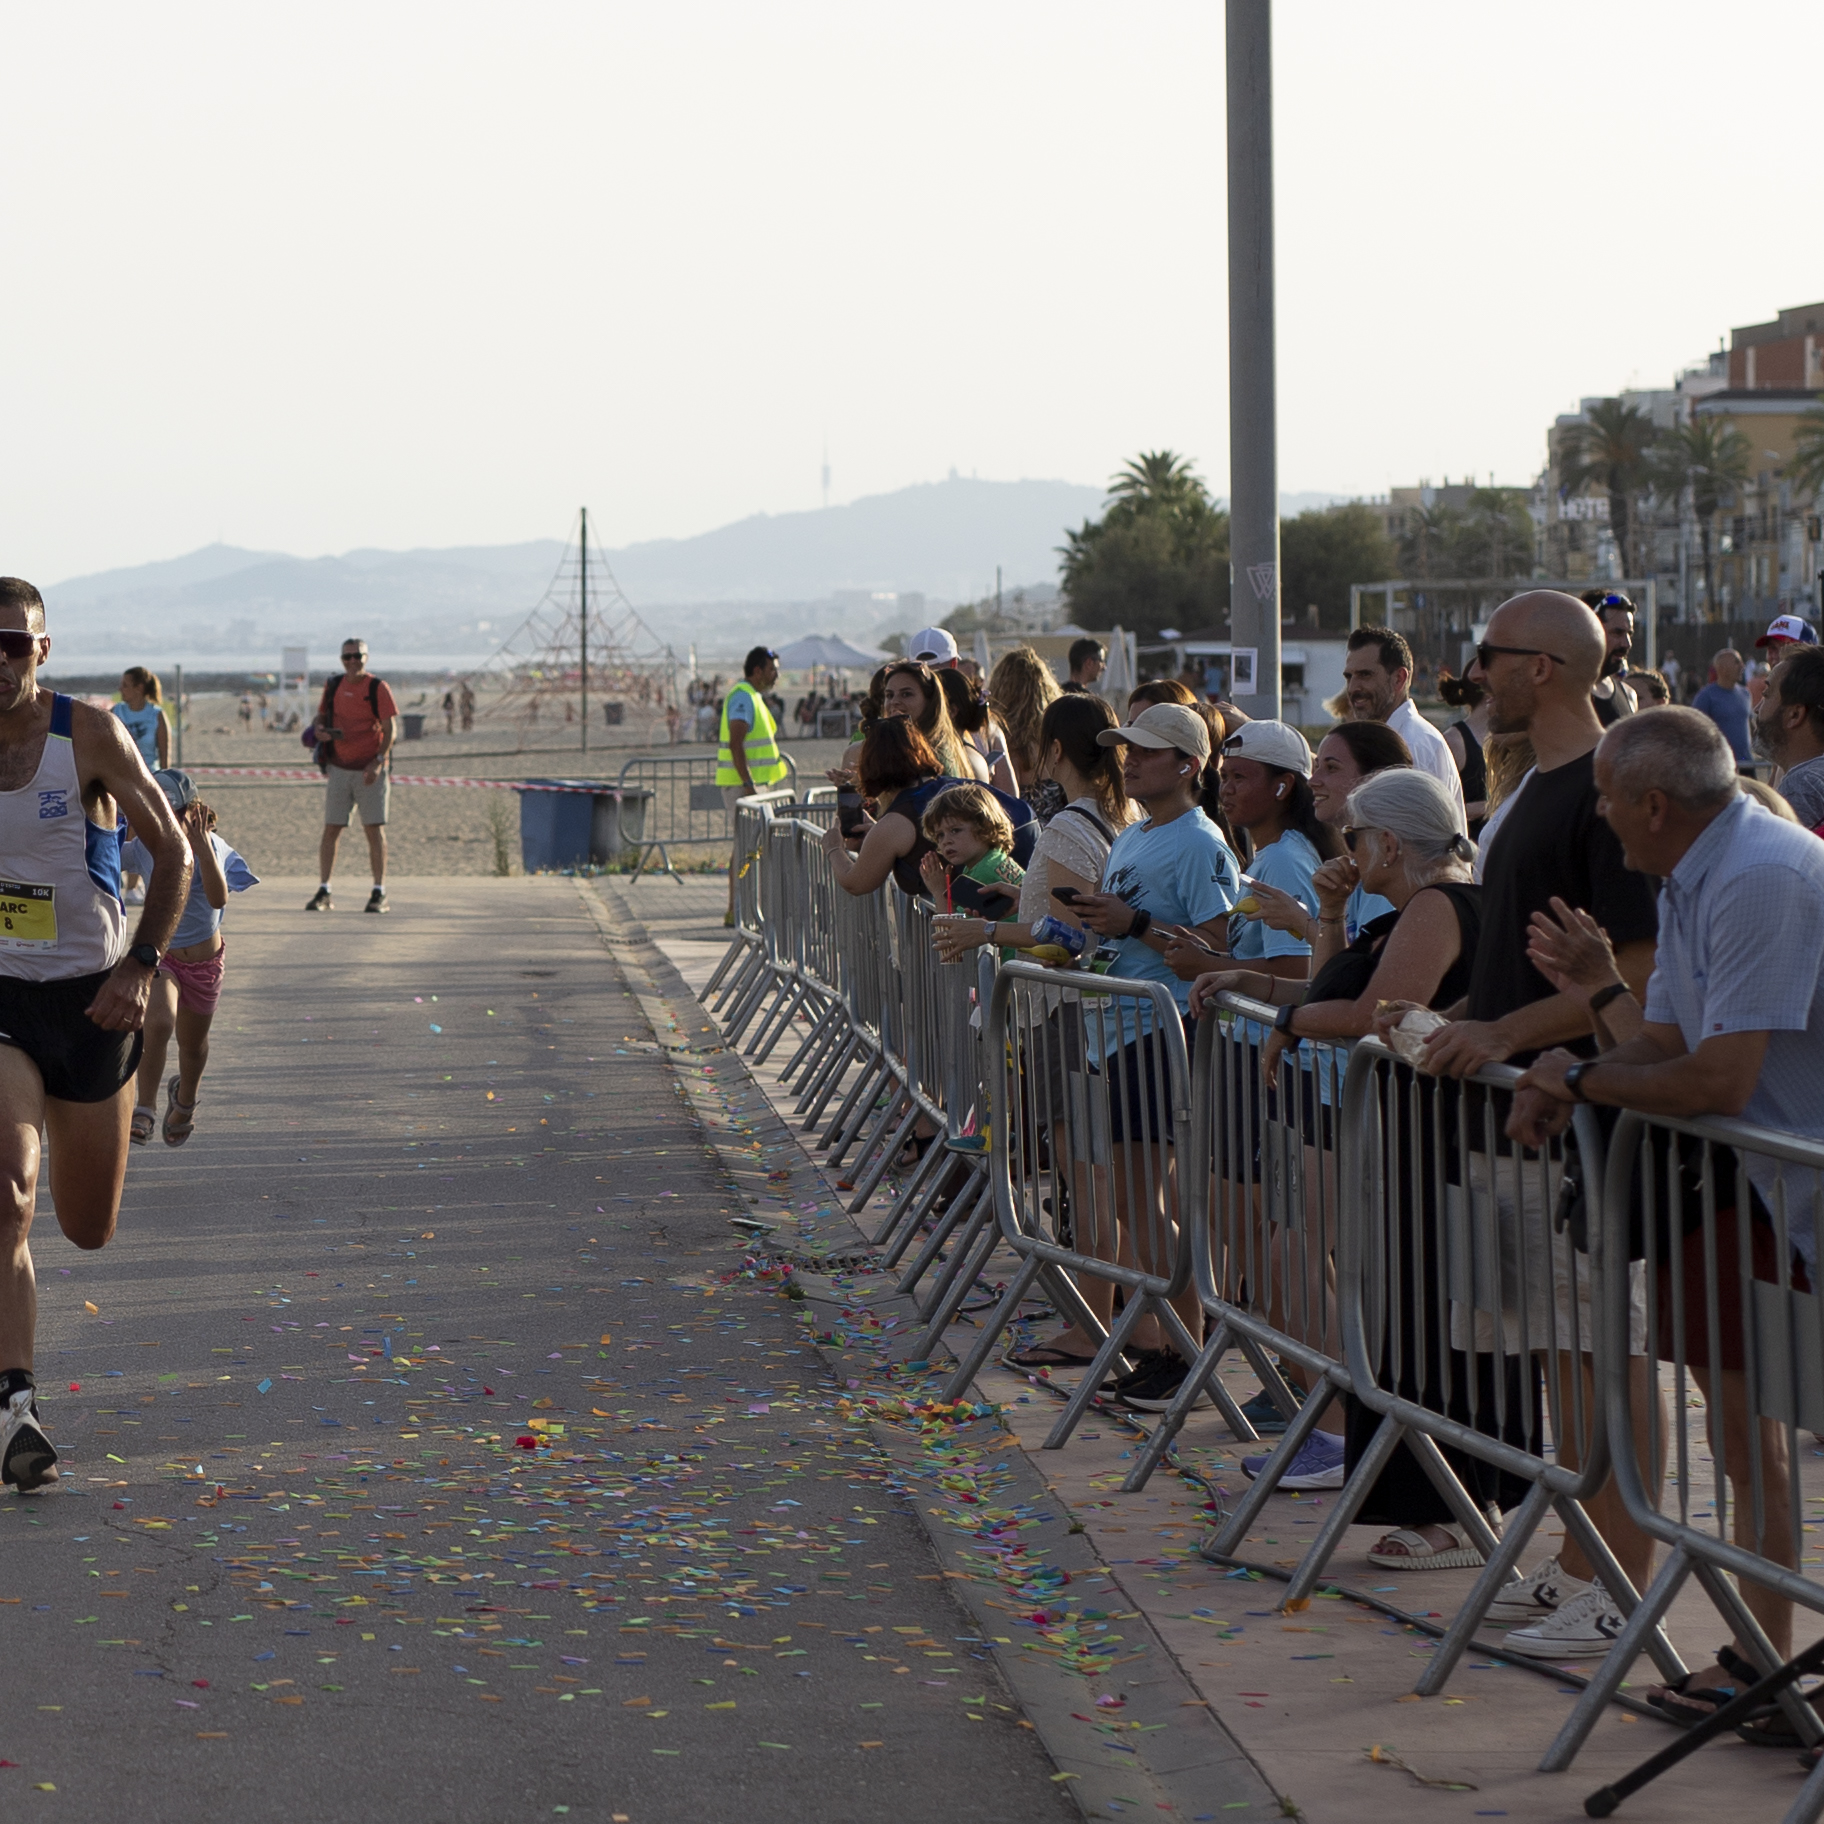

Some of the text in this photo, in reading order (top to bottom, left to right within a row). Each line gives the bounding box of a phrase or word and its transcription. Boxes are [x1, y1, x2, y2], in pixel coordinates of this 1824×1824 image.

[1559, 497, 1610, 520] HOTE
[32, 888, 50, 896] 10K
[4, 917, 13, 930] 8
